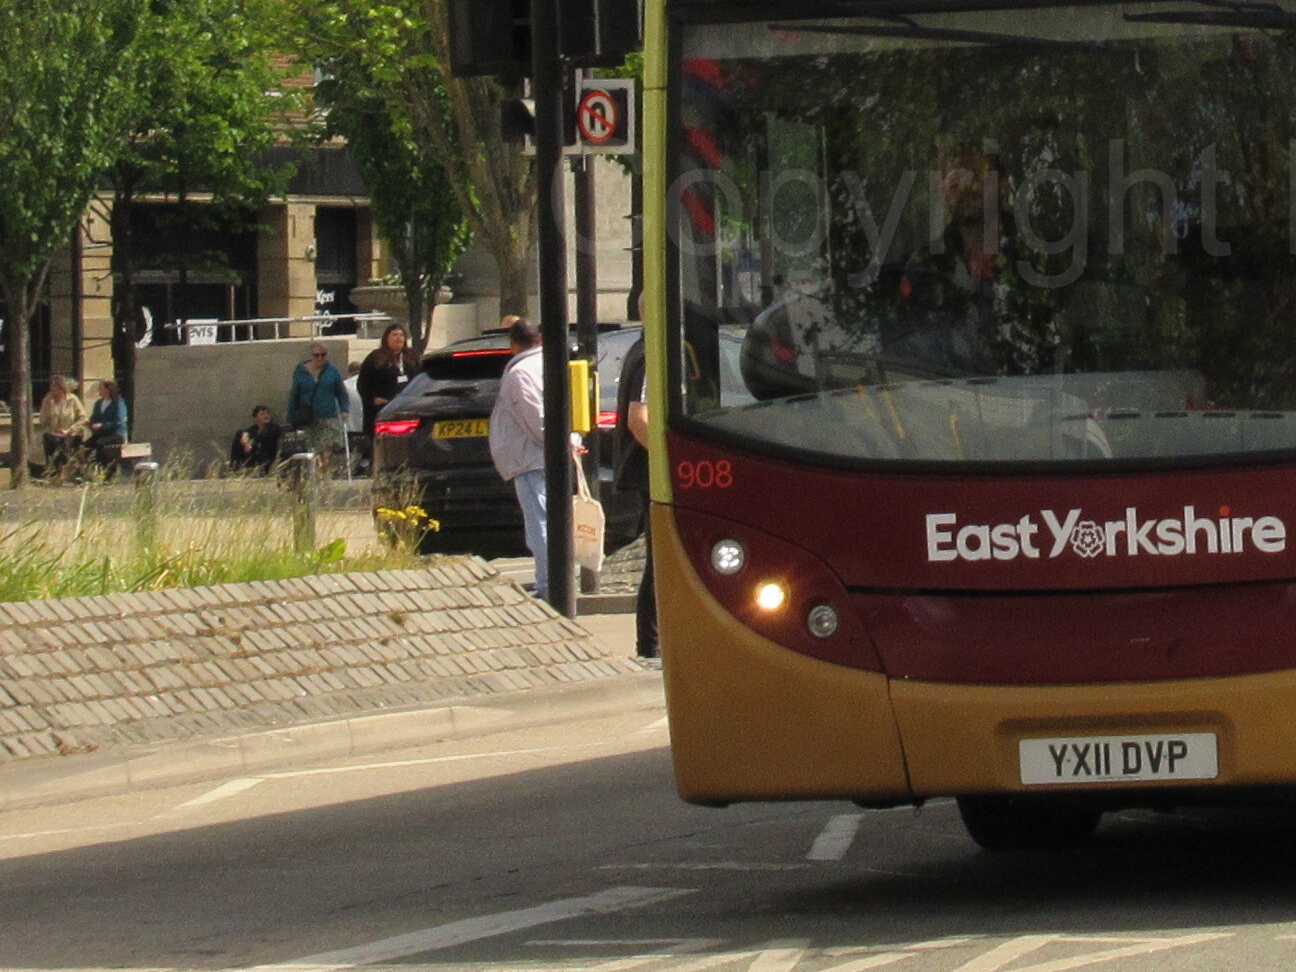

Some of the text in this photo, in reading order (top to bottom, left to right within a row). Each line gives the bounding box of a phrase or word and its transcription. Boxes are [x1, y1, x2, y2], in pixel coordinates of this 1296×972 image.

[677, 460, 733, 489] 908
[925, 512, 1041, 562] East
[1049, 739, 1188, 777] YX11 DVP
